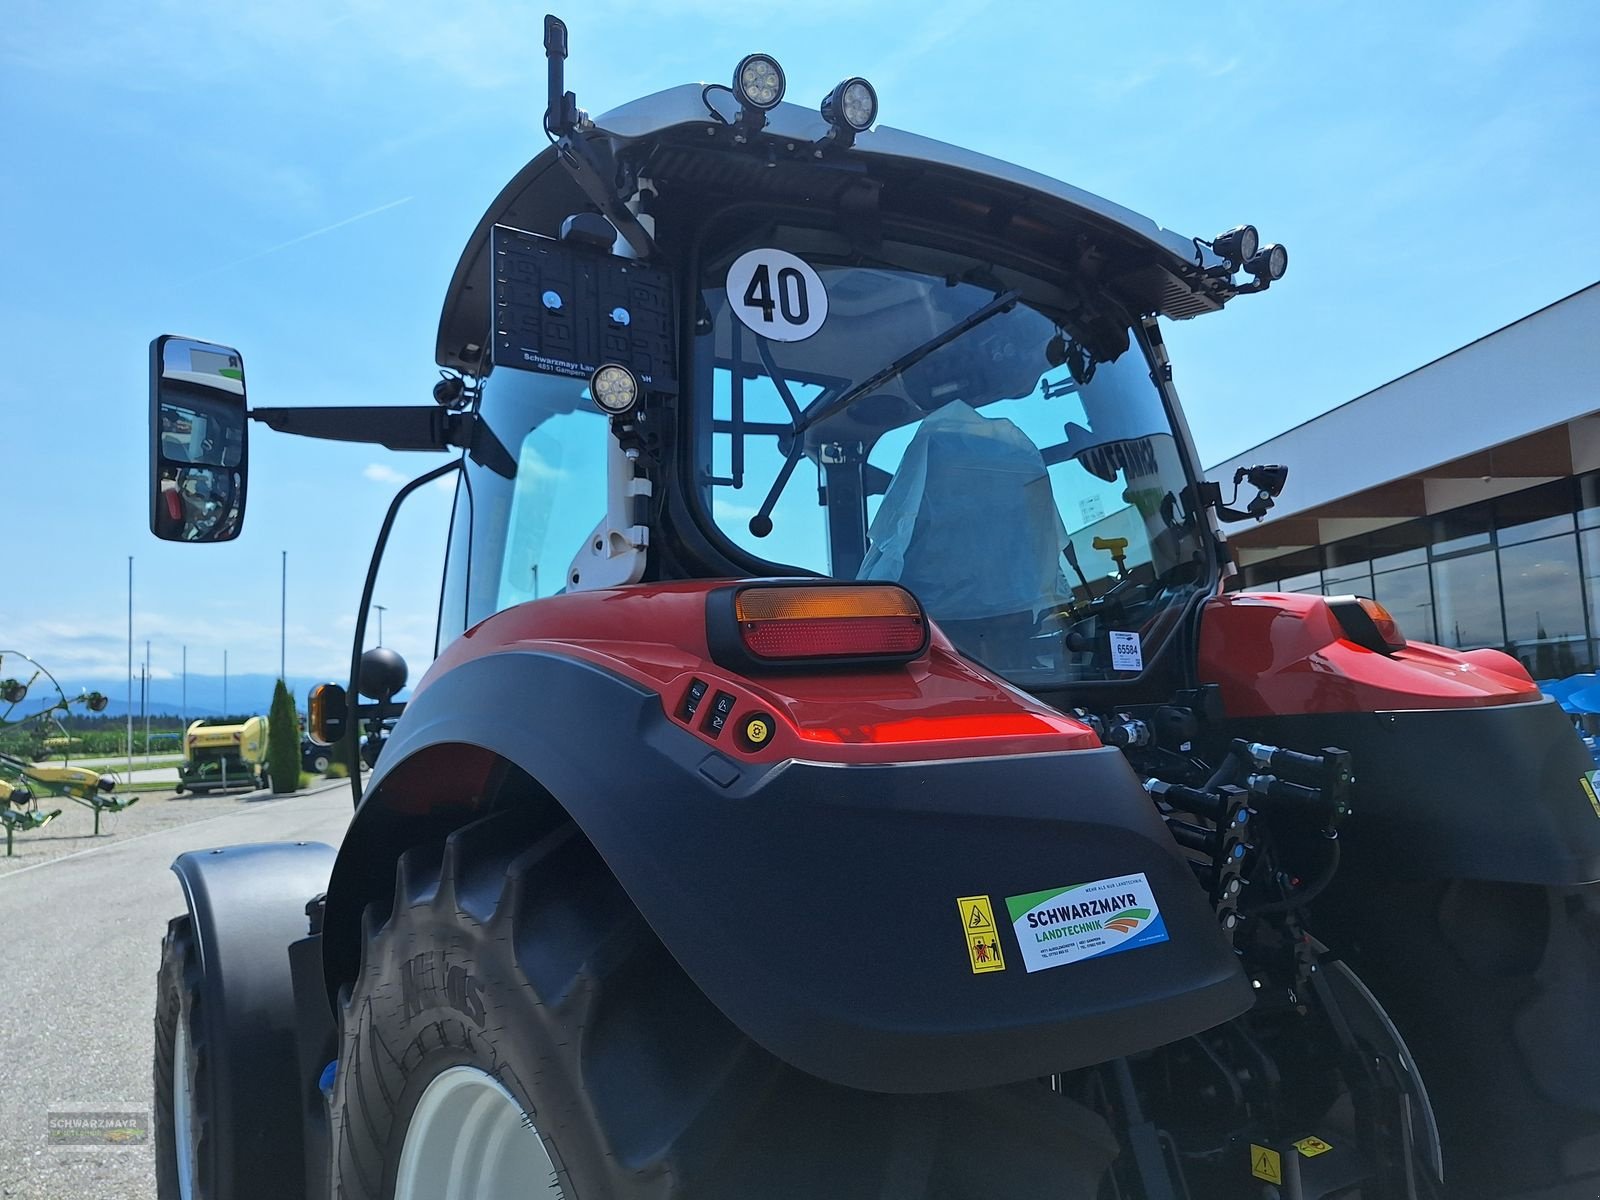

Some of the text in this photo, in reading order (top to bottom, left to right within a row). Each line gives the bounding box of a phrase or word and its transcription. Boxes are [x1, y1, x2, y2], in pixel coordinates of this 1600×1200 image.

[743, 264, 810, 326] 40
[523, 353, 595, 372] Schwarzmayr Lan
[555, 366, 586, 377] Gampern
[1026, 893, 1138, 929] SCHWARZMAYR
[1035, 919, 1103, 943] LANDTECHNIK
